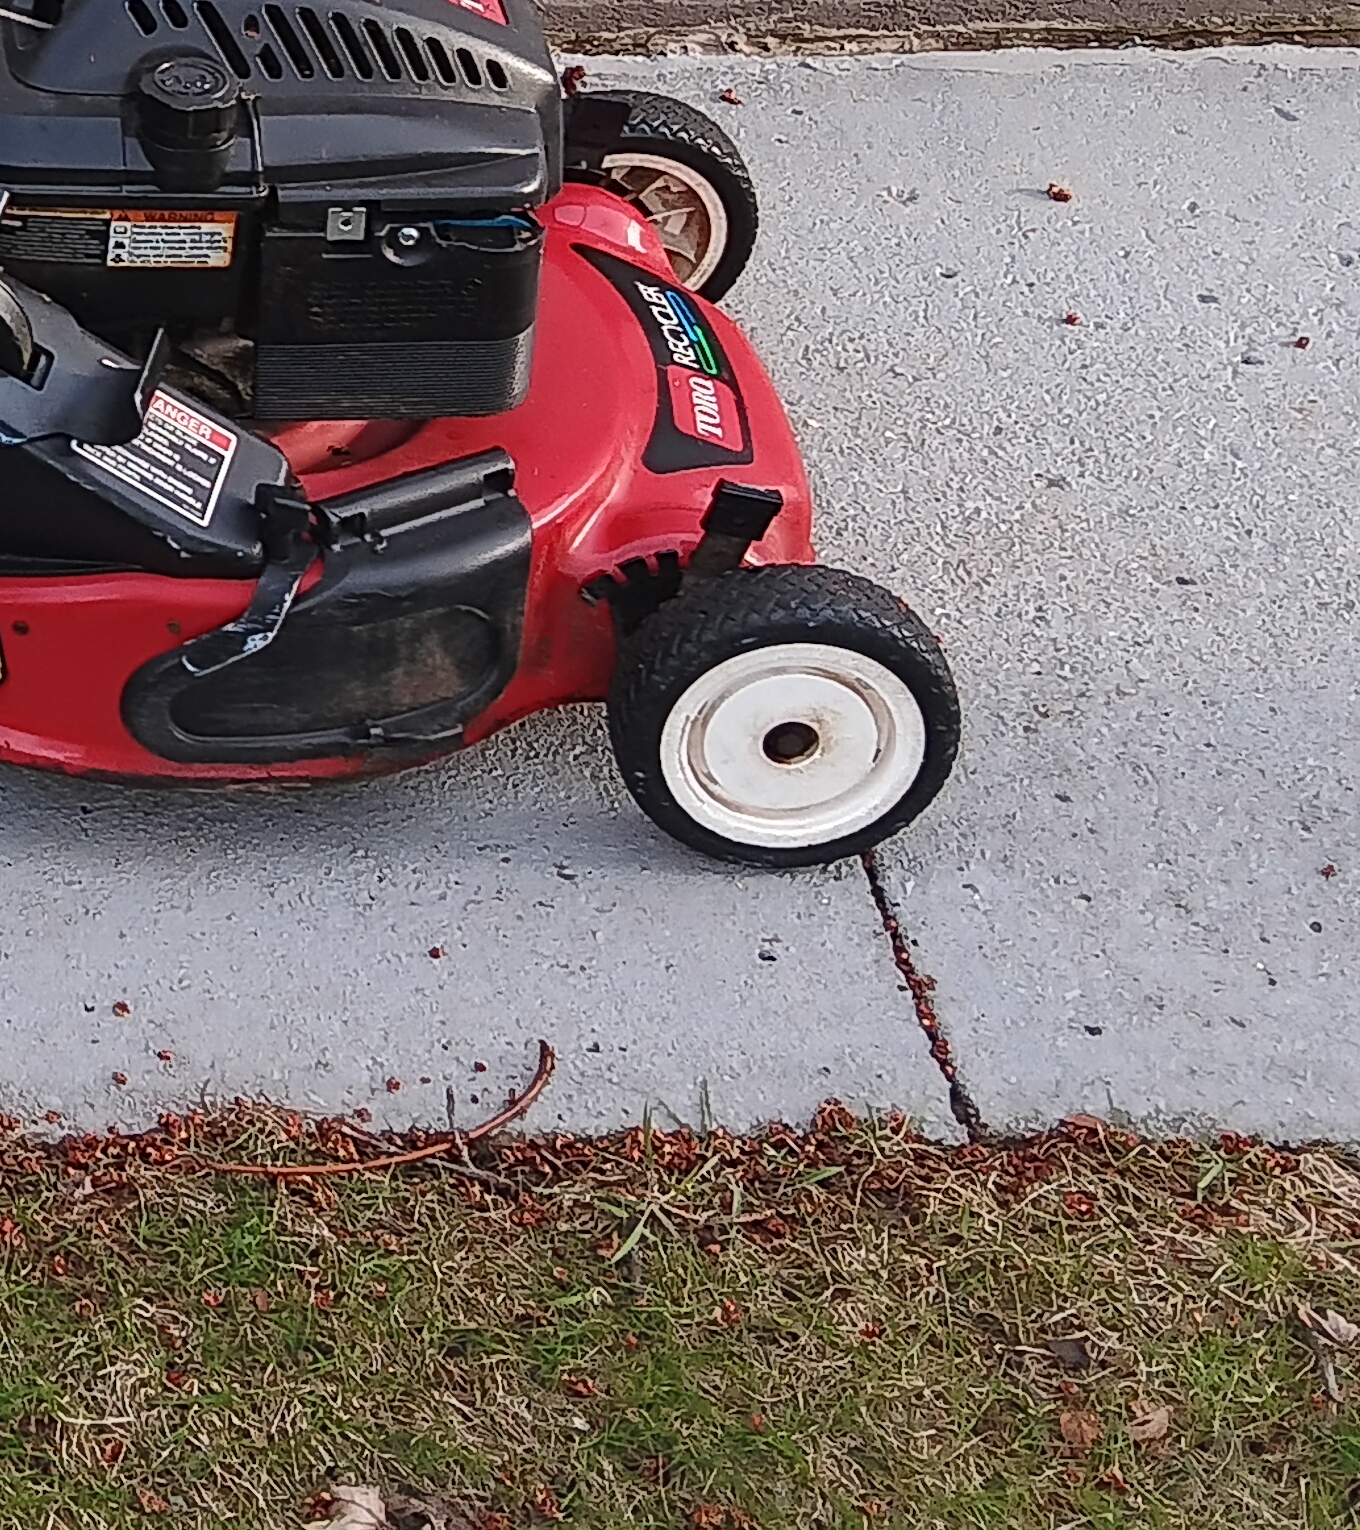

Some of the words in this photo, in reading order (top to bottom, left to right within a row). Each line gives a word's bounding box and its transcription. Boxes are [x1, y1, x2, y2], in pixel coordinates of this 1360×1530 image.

[634, 280, 701, 369] RECYCLER
[152, 398, 213, 440] ANGER
[688, 376, 723, 440] TORO
